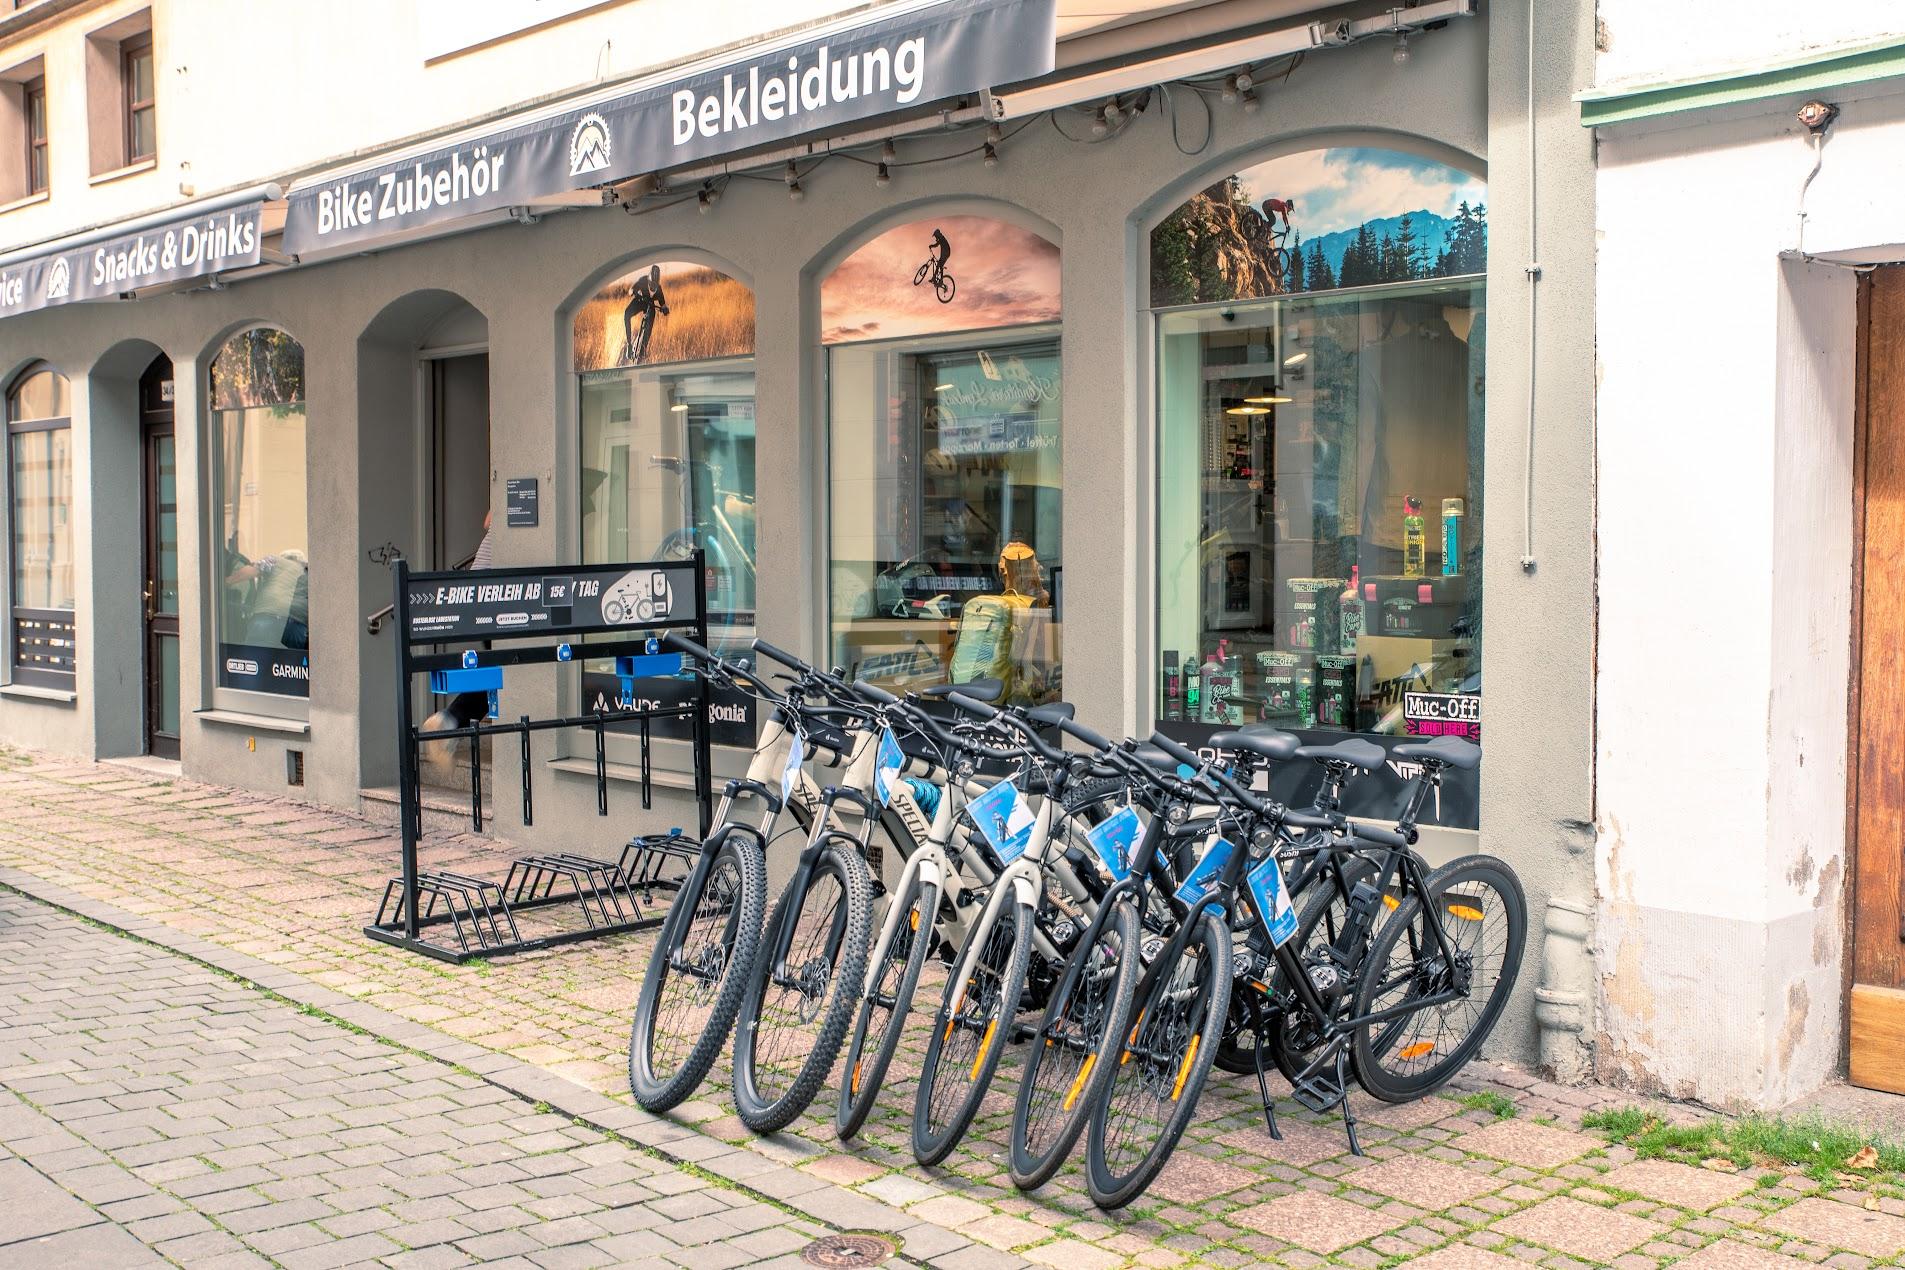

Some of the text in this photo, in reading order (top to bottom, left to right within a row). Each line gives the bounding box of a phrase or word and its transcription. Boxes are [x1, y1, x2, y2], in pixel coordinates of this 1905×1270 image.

[672, 37, 925, 146] Bekleidung
[317, 145, 505, 234] Bike Zubehör
[93, 214, 255, 286] Snacks & Drinks
[435, 586, 475, 605] E-BIKE
[477, 583, 523, 603] VERLEIH
[524, 583, 542, 600] AB
[550, 585, 566, 598] 15€
[578, 580, 600, 598] TAG
[272, 663, 309, 680] GARMIN
[1408, 697, 1478, 719] Muc-Off
[1419, 723, 1467, 736] SOLD HERE
